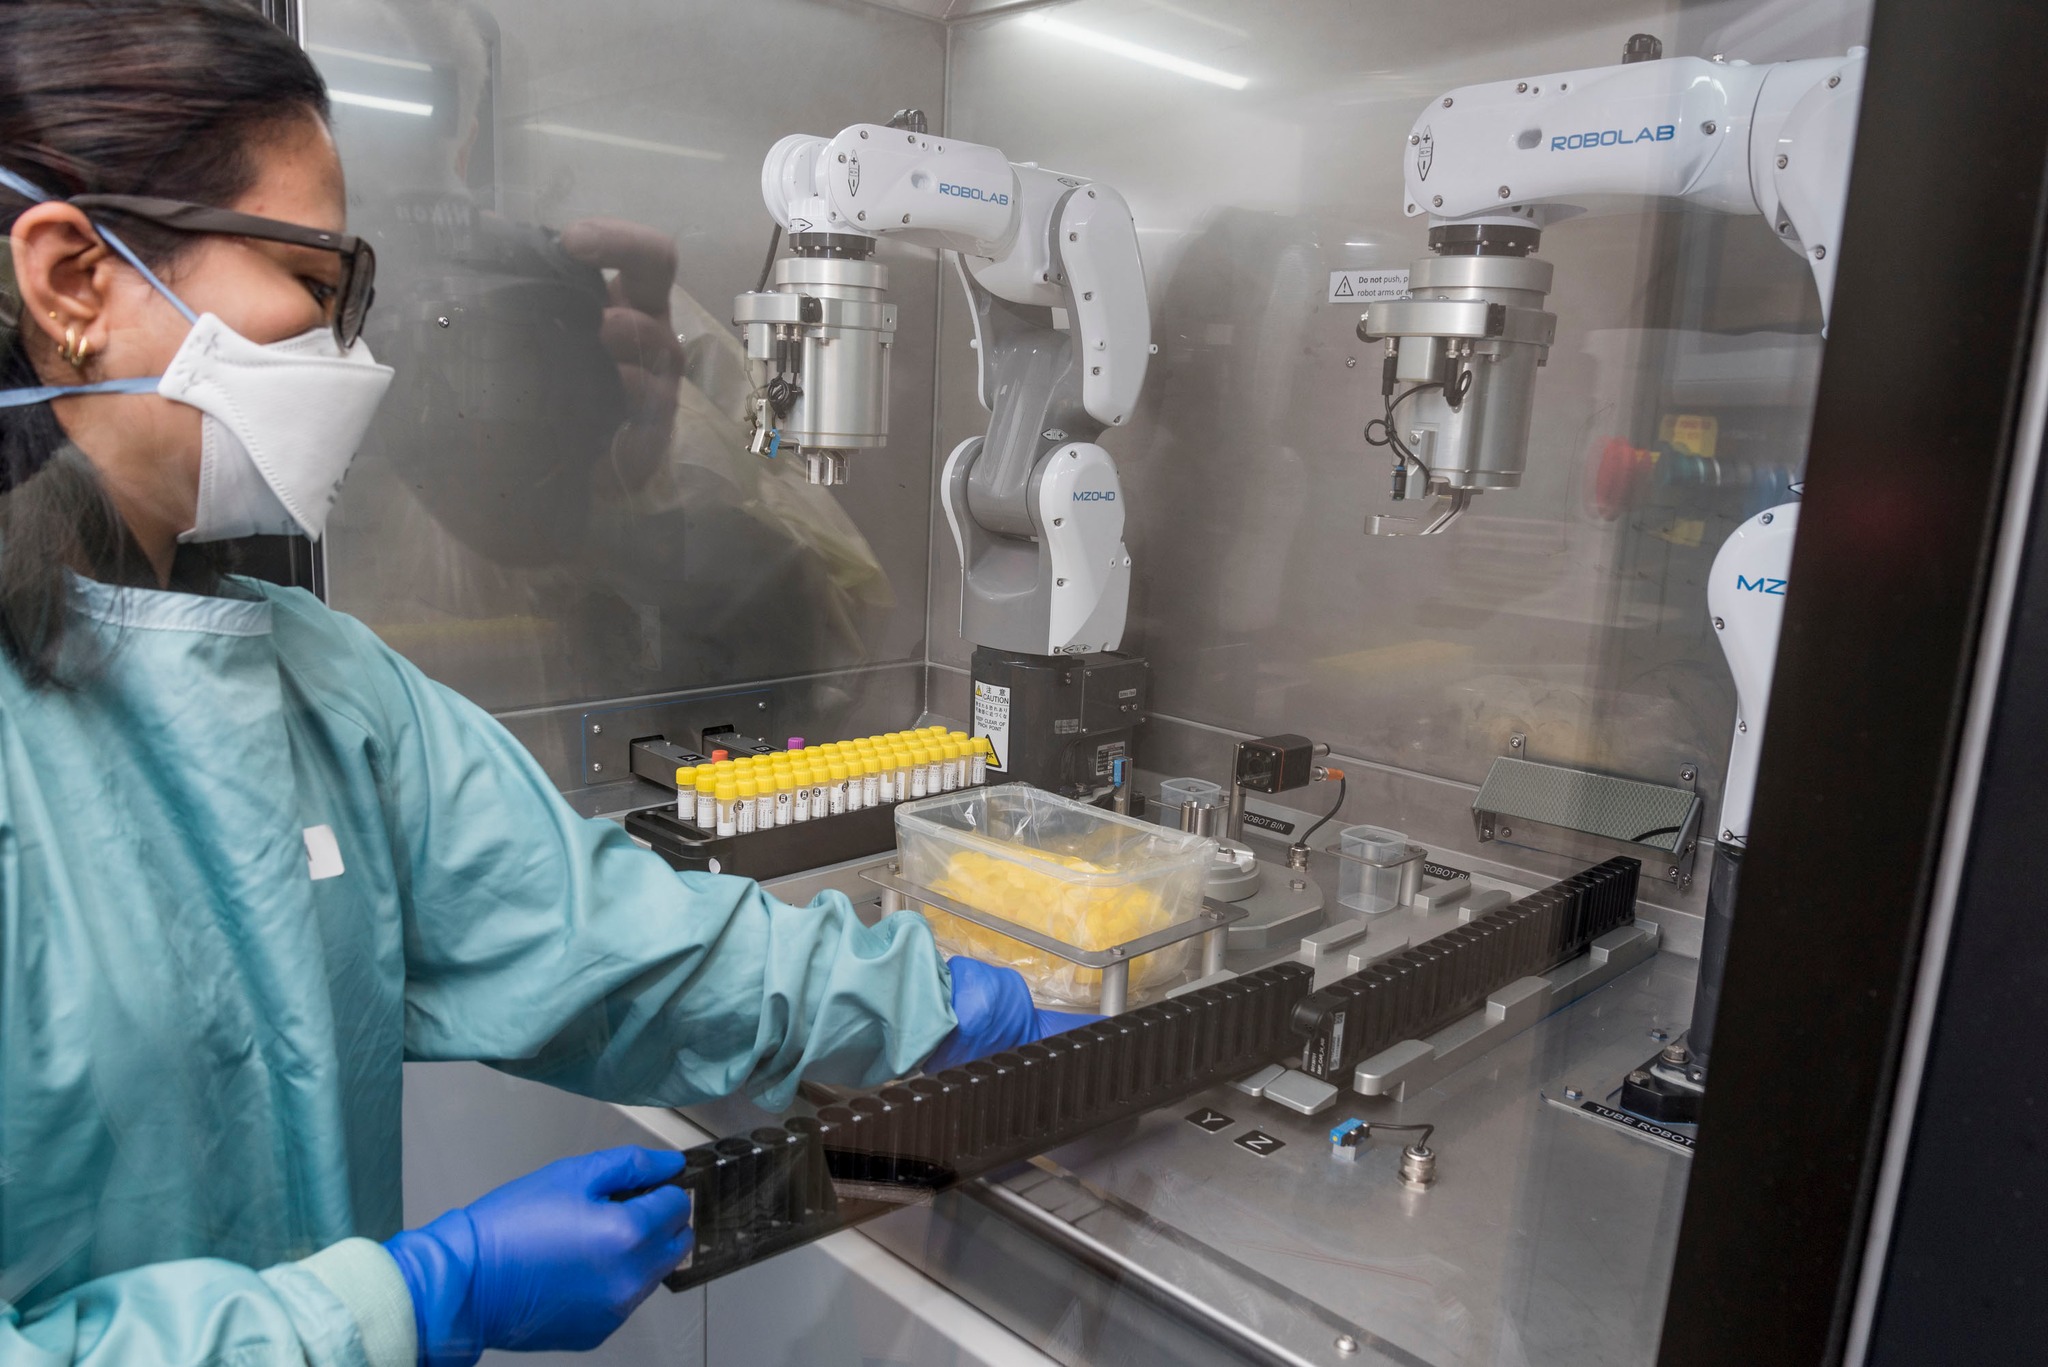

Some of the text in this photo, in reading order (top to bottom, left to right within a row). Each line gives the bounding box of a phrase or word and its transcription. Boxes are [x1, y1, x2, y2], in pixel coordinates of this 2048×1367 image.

[1550, 124, 1675, 152] ROBOLAB
[939, 183, 1009, 206] ROBOLAB
[1358, 276, 1368, 284] Do
[1370, 276, 1382, 284] not
[1383, 275, 1402, 284] push,
[983, 693, 1009, 704] CAUTION
[984, 718, 997, 726] CLEAR
[1243, 813, 1286, 831] ROBOT BIN
[1423, 863, 1457, 879] ROBOT
[1201, 1112, 1224, 1124] Y
[1596, 1105, 1696, 1146] TUBE ROBOT
[1245, 1135, 1273, 1150] Z
